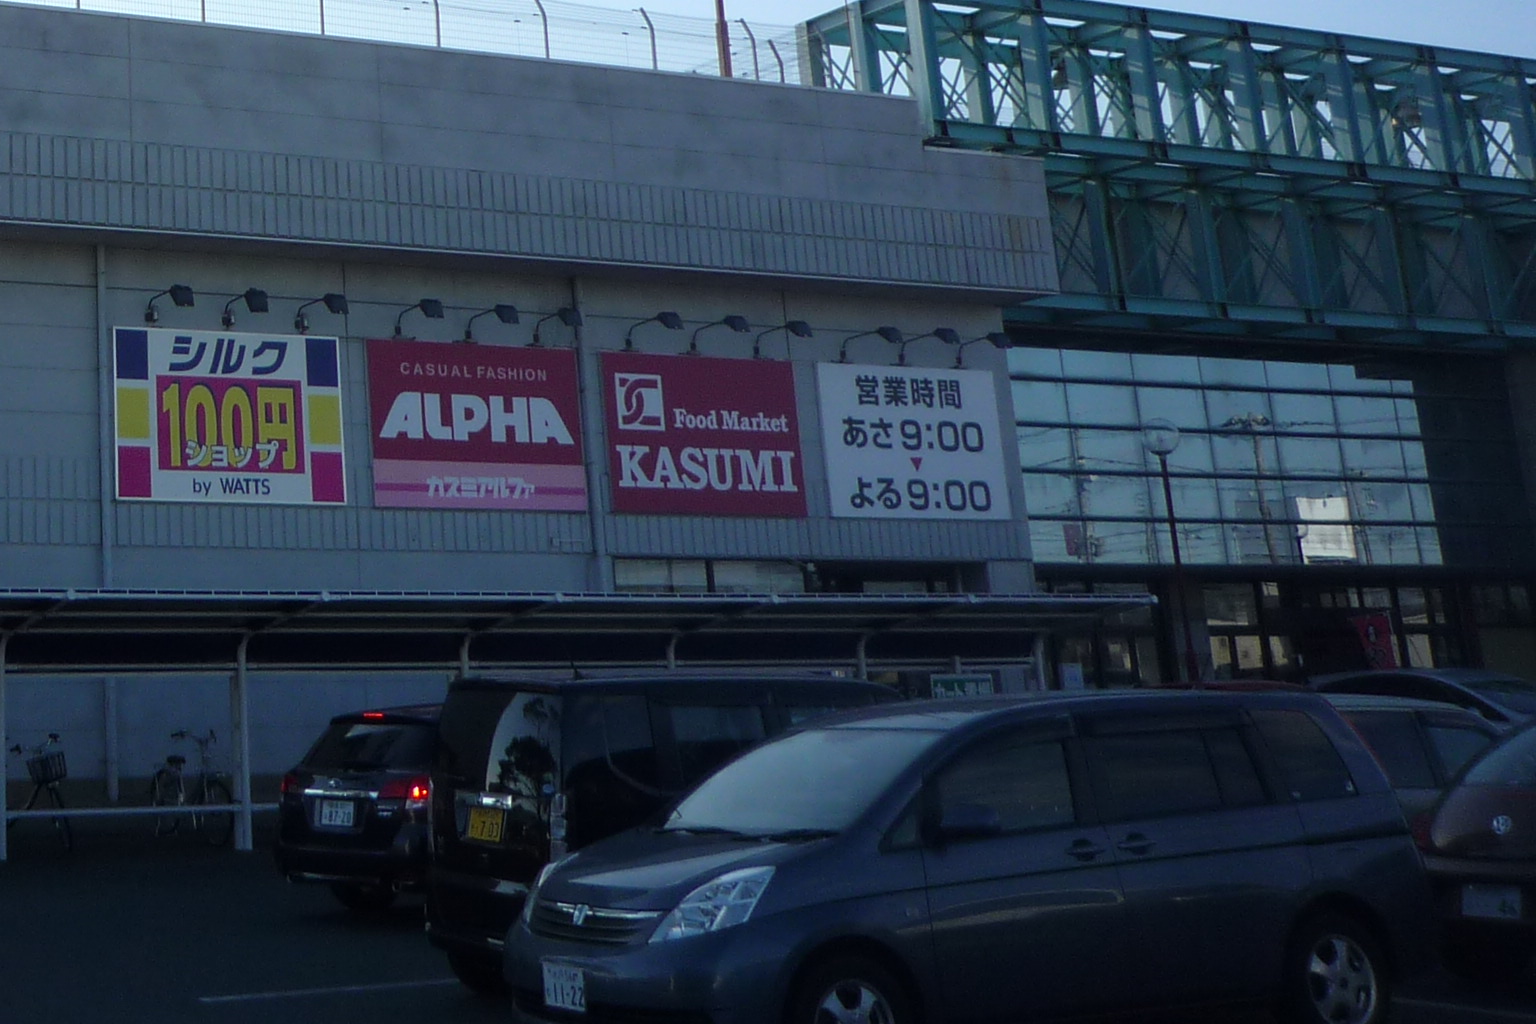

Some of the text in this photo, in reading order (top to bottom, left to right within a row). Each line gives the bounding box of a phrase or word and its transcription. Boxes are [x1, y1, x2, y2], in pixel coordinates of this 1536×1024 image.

[168, 336, 288, 375] シルク
[400, 362, 547, 382] CASUAL FASHION
[855, 375, 962, 410] 営業時間
[161, 381, 297, 471] 100円
[379, 391, 575, 445] ALPHA
[673, 408, 789, 433] Food Market
[185, 439, 280, 470] ショップ
[616, 445, 798, 492] KASUMI
[193, 478, 270, 496] by WATTS
[427, 476, 535, 499] カスミアルファ
